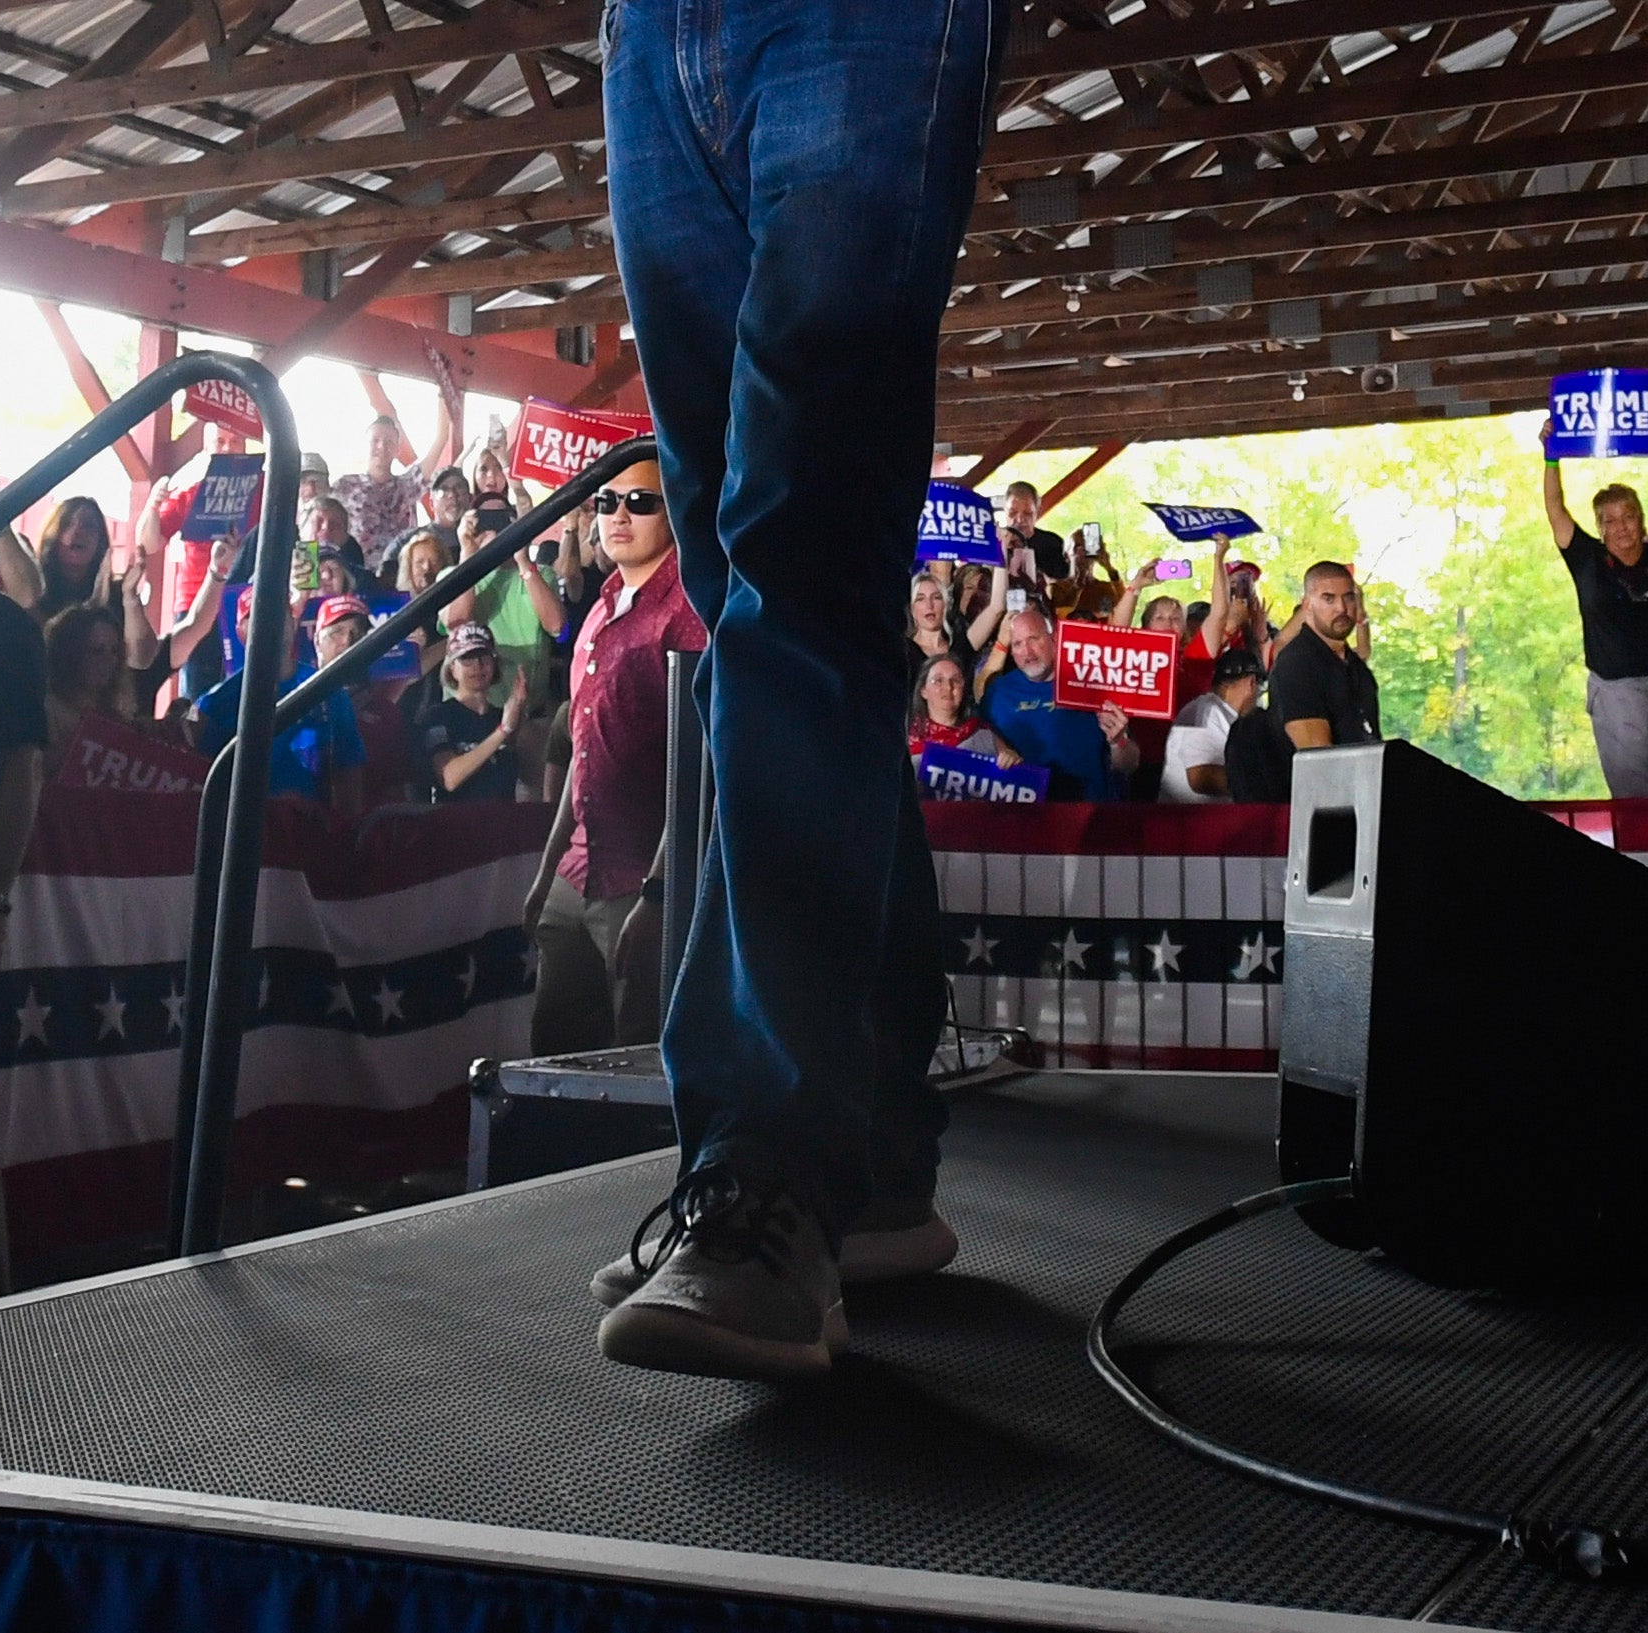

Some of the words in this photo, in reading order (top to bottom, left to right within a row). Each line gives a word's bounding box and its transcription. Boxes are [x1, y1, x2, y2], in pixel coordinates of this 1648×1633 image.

[197, 385, 257, 416] VANCE
[526, 422, 613, 459] TRUM
[533, 444, 596, 470] VANC
[205, 474, 258, 497] TRUMP
[205, 496, 248, 513] VANCE
[922, 500, 992, 525] RUMP
[918, 516, 985, 539] ANCE
[1063, 641, 1169, 673] TRUMP
[1073, 663, 1156, 689] VANCE
[81, 739, 203, 793] TRUM
[927, 765, 1037, 803] TRUMP
